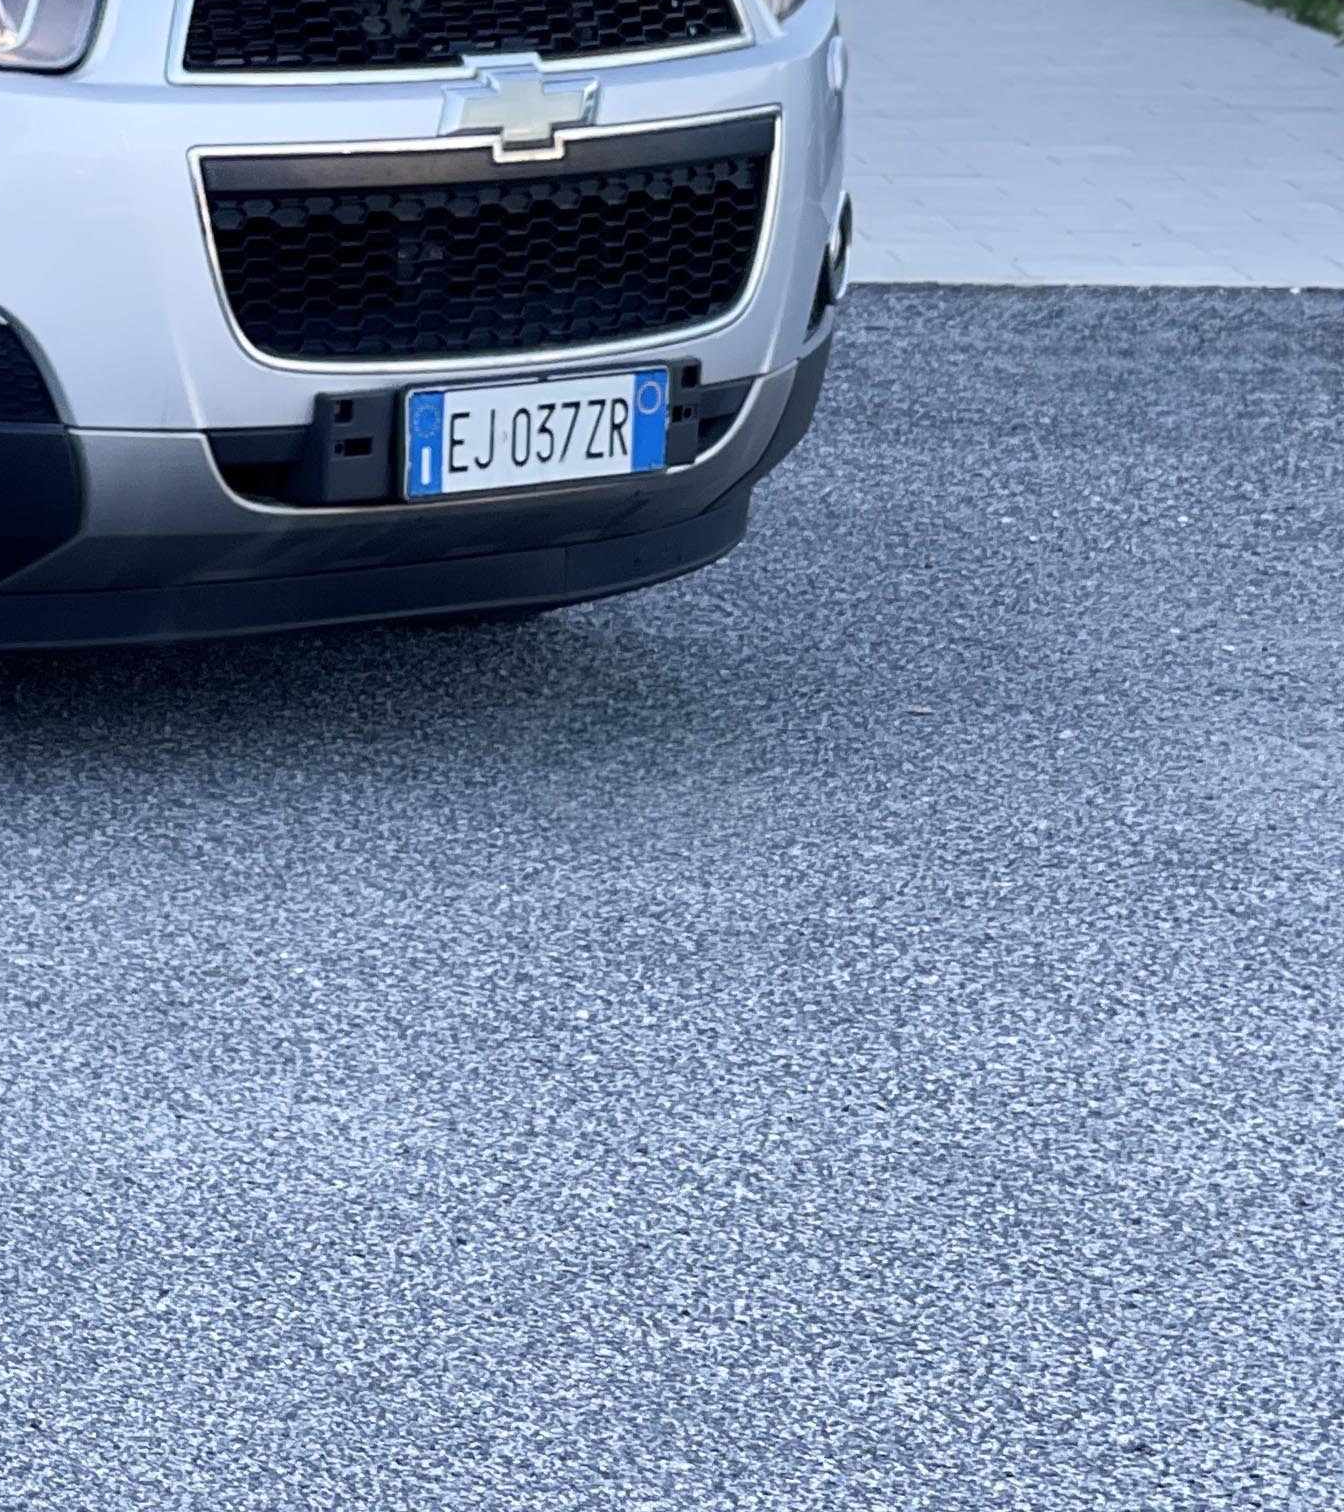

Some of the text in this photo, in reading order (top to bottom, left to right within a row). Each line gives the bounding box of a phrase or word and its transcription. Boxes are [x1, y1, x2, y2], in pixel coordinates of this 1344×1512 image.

[420, 397, 629, 485] I EJ 037ZR
